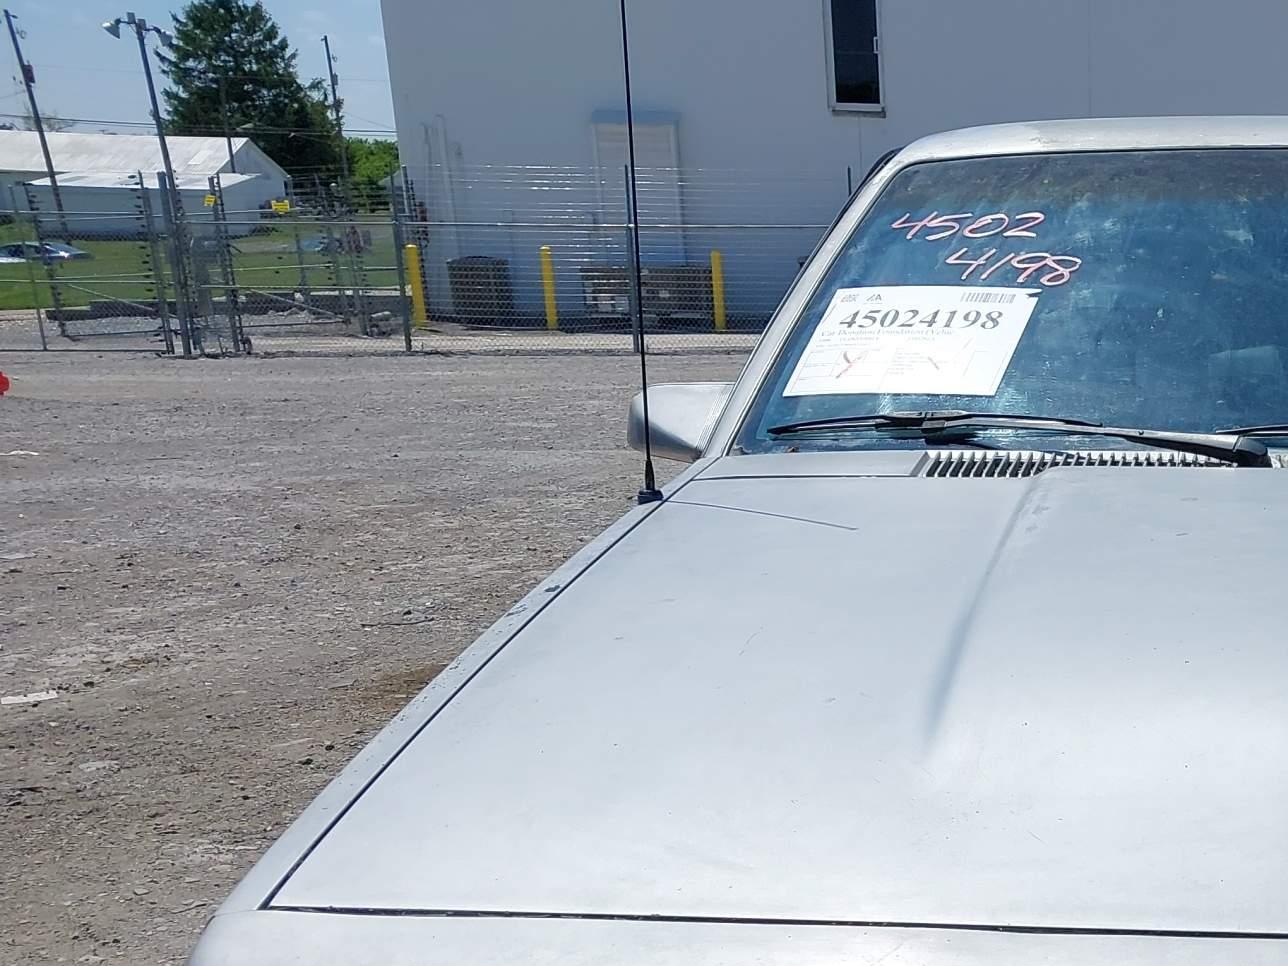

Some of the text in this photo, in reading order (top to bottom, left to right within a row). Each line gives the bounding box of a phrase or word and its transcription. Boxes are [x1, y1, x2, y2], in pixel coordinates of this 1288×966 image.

[891, 211, 1045, 241] 4502
[945, 247, 1082, 286] 4198
[839, 308, 1004, 331] 45024198
